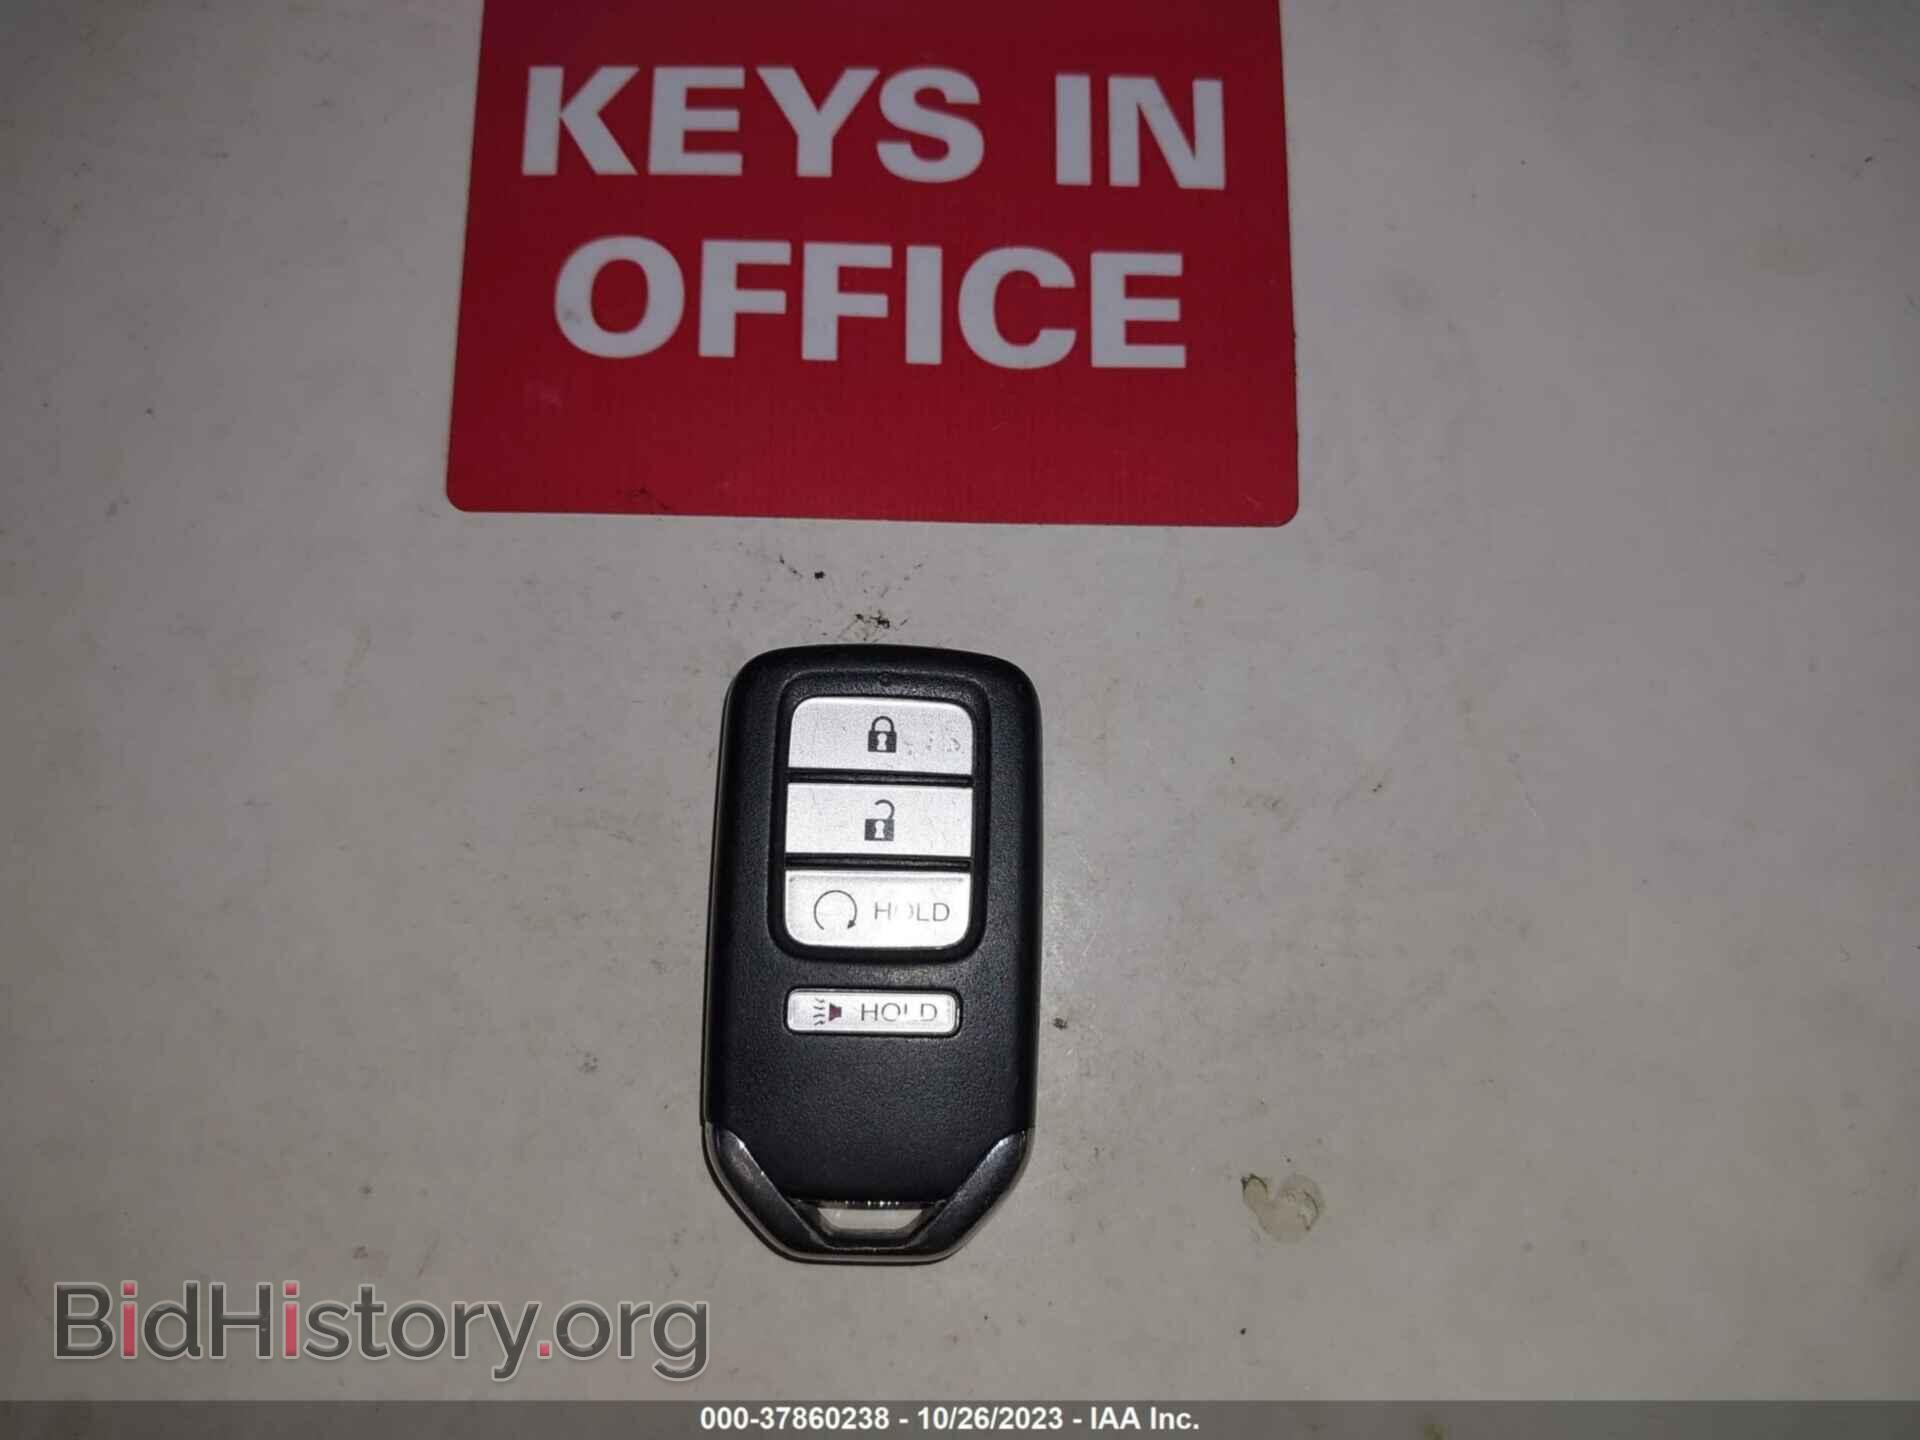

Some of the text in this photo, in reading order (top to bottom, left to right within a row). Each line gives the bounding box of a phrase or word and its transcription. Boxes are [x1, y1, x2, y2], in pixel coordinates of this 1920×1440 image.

[522, 66, 1225, 189] KEYS IN
[554, 235, 1186, 369] OFFICE
